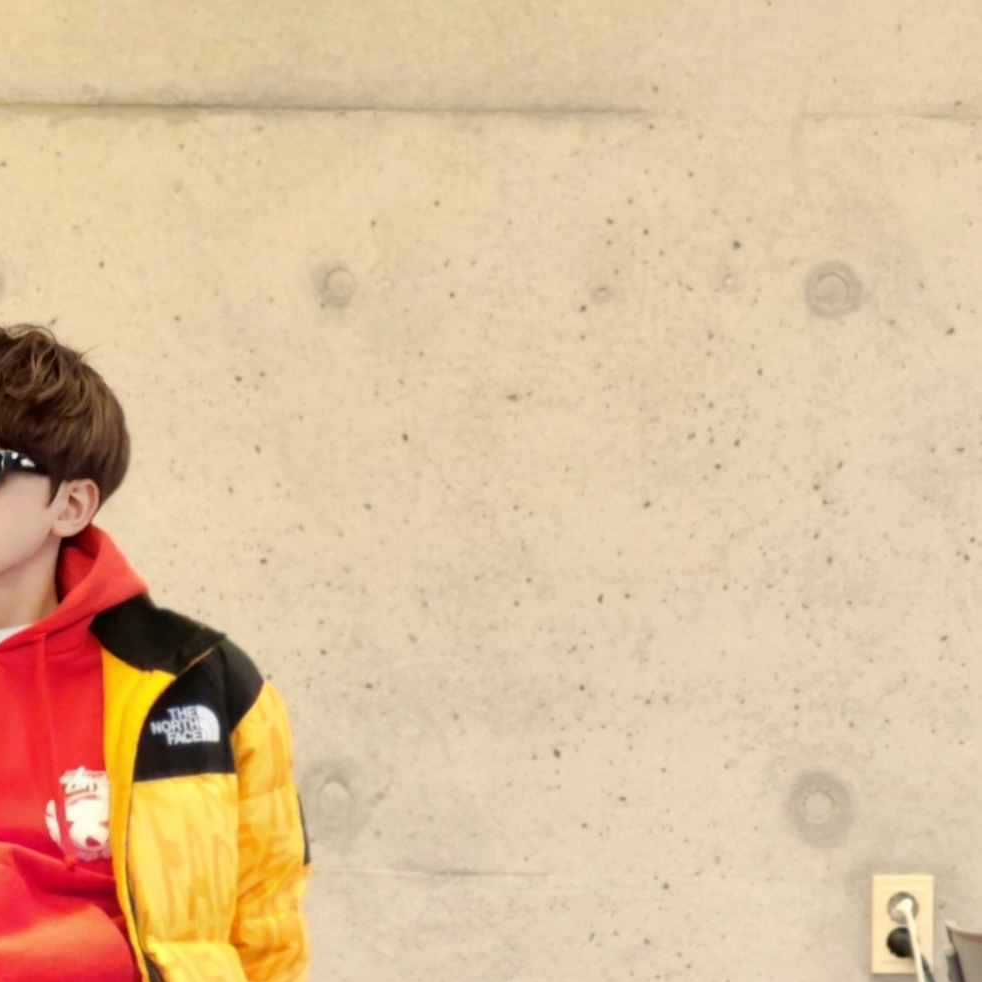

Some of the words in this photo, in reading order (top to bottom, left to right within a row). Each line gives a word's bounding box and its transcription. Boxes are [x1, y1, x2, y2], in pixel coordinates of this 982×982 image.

[167, 706, 197, 720] THE
[150, 716, 200, 735] NORTH
[167, 729, 203, 745] FACE
